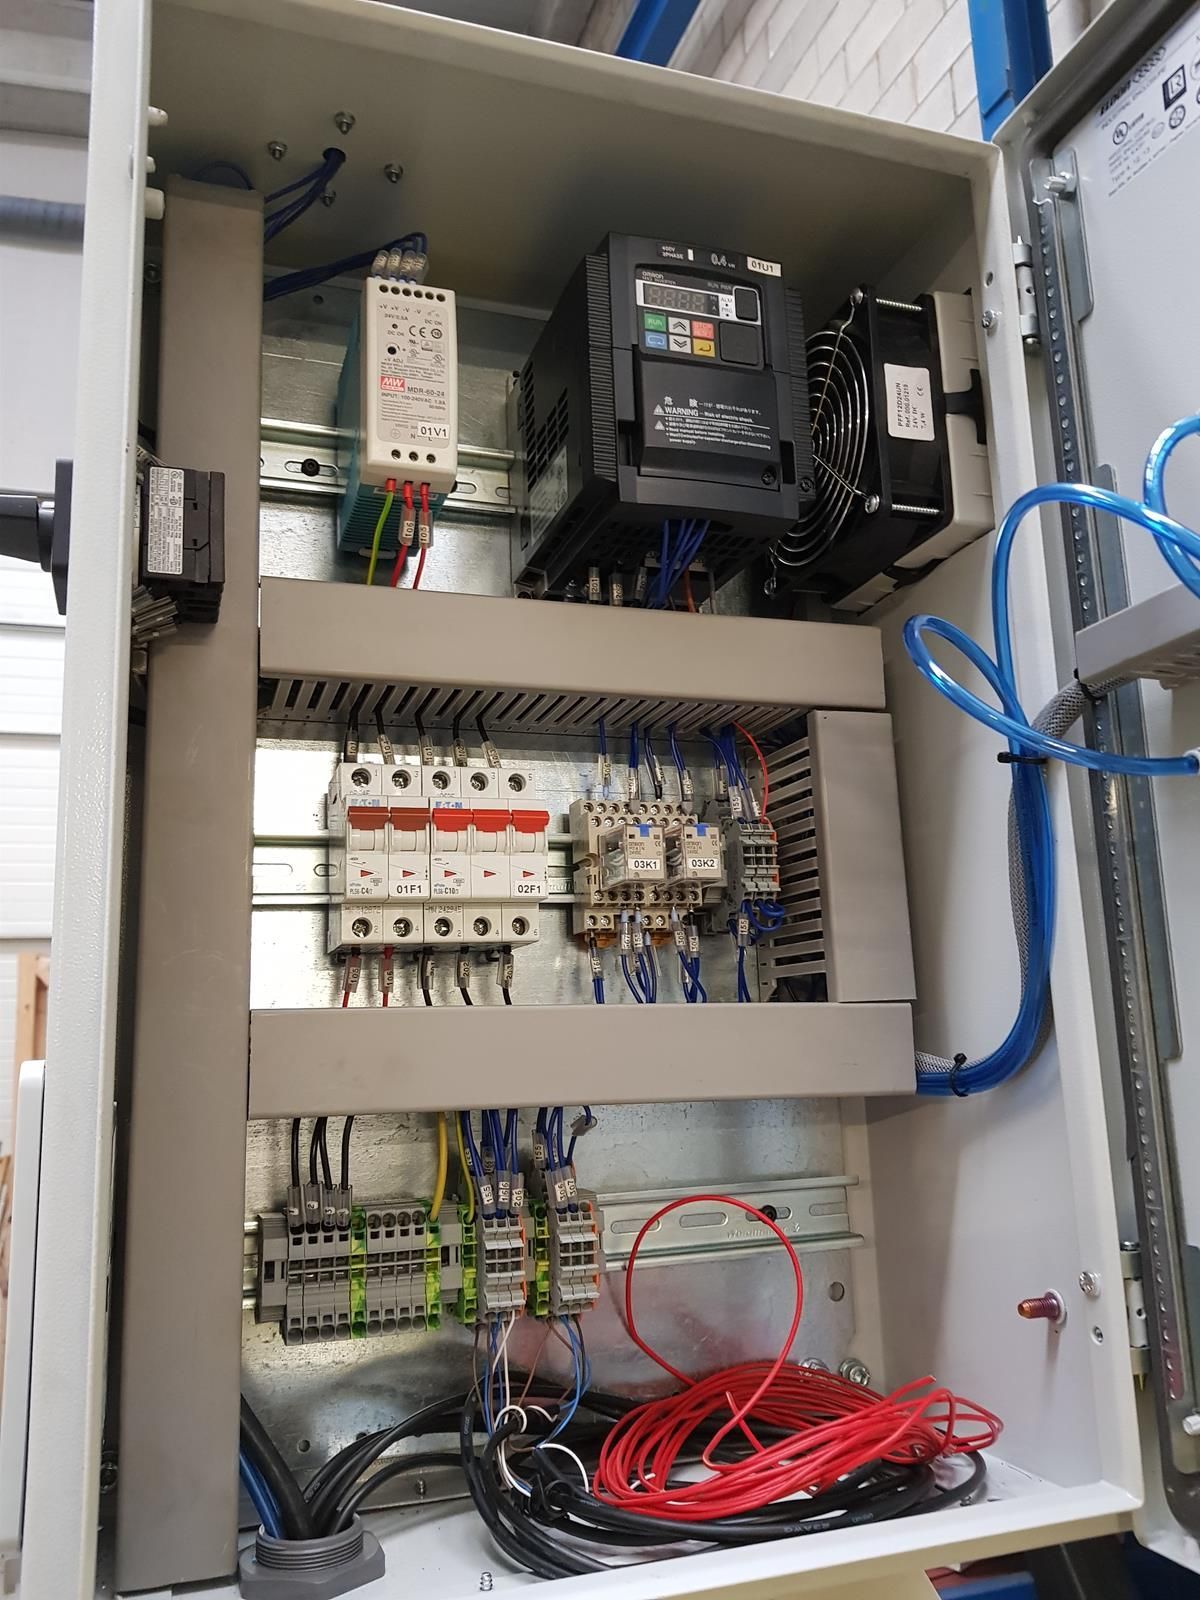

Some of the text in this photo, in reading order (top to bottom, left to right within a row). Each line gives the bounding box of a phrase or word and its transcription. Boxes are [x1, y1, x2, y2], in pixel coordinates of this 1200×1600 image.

[751, 260, 774, 272] 01U1
[664, 406, 698, 416] WARNING
[420, 426, 446, 437] 01V1
[404, 522, 414, 538] 106
[420, 526, 430, 542] 105
[591, 578, 599, 593] 201
[634, 860, 657, 869] 03K1
[692, 860, 715, 868] 03K2
[396, 884, 422, 894] 01F1
[518, 884, 541, 894] 02F1
[351, 968, 359, 983] 105
[483, 1186, 492, 1203] 155
[557, 1183, 566, 1200] 306
[514, 1190, 523, 1207] 206
